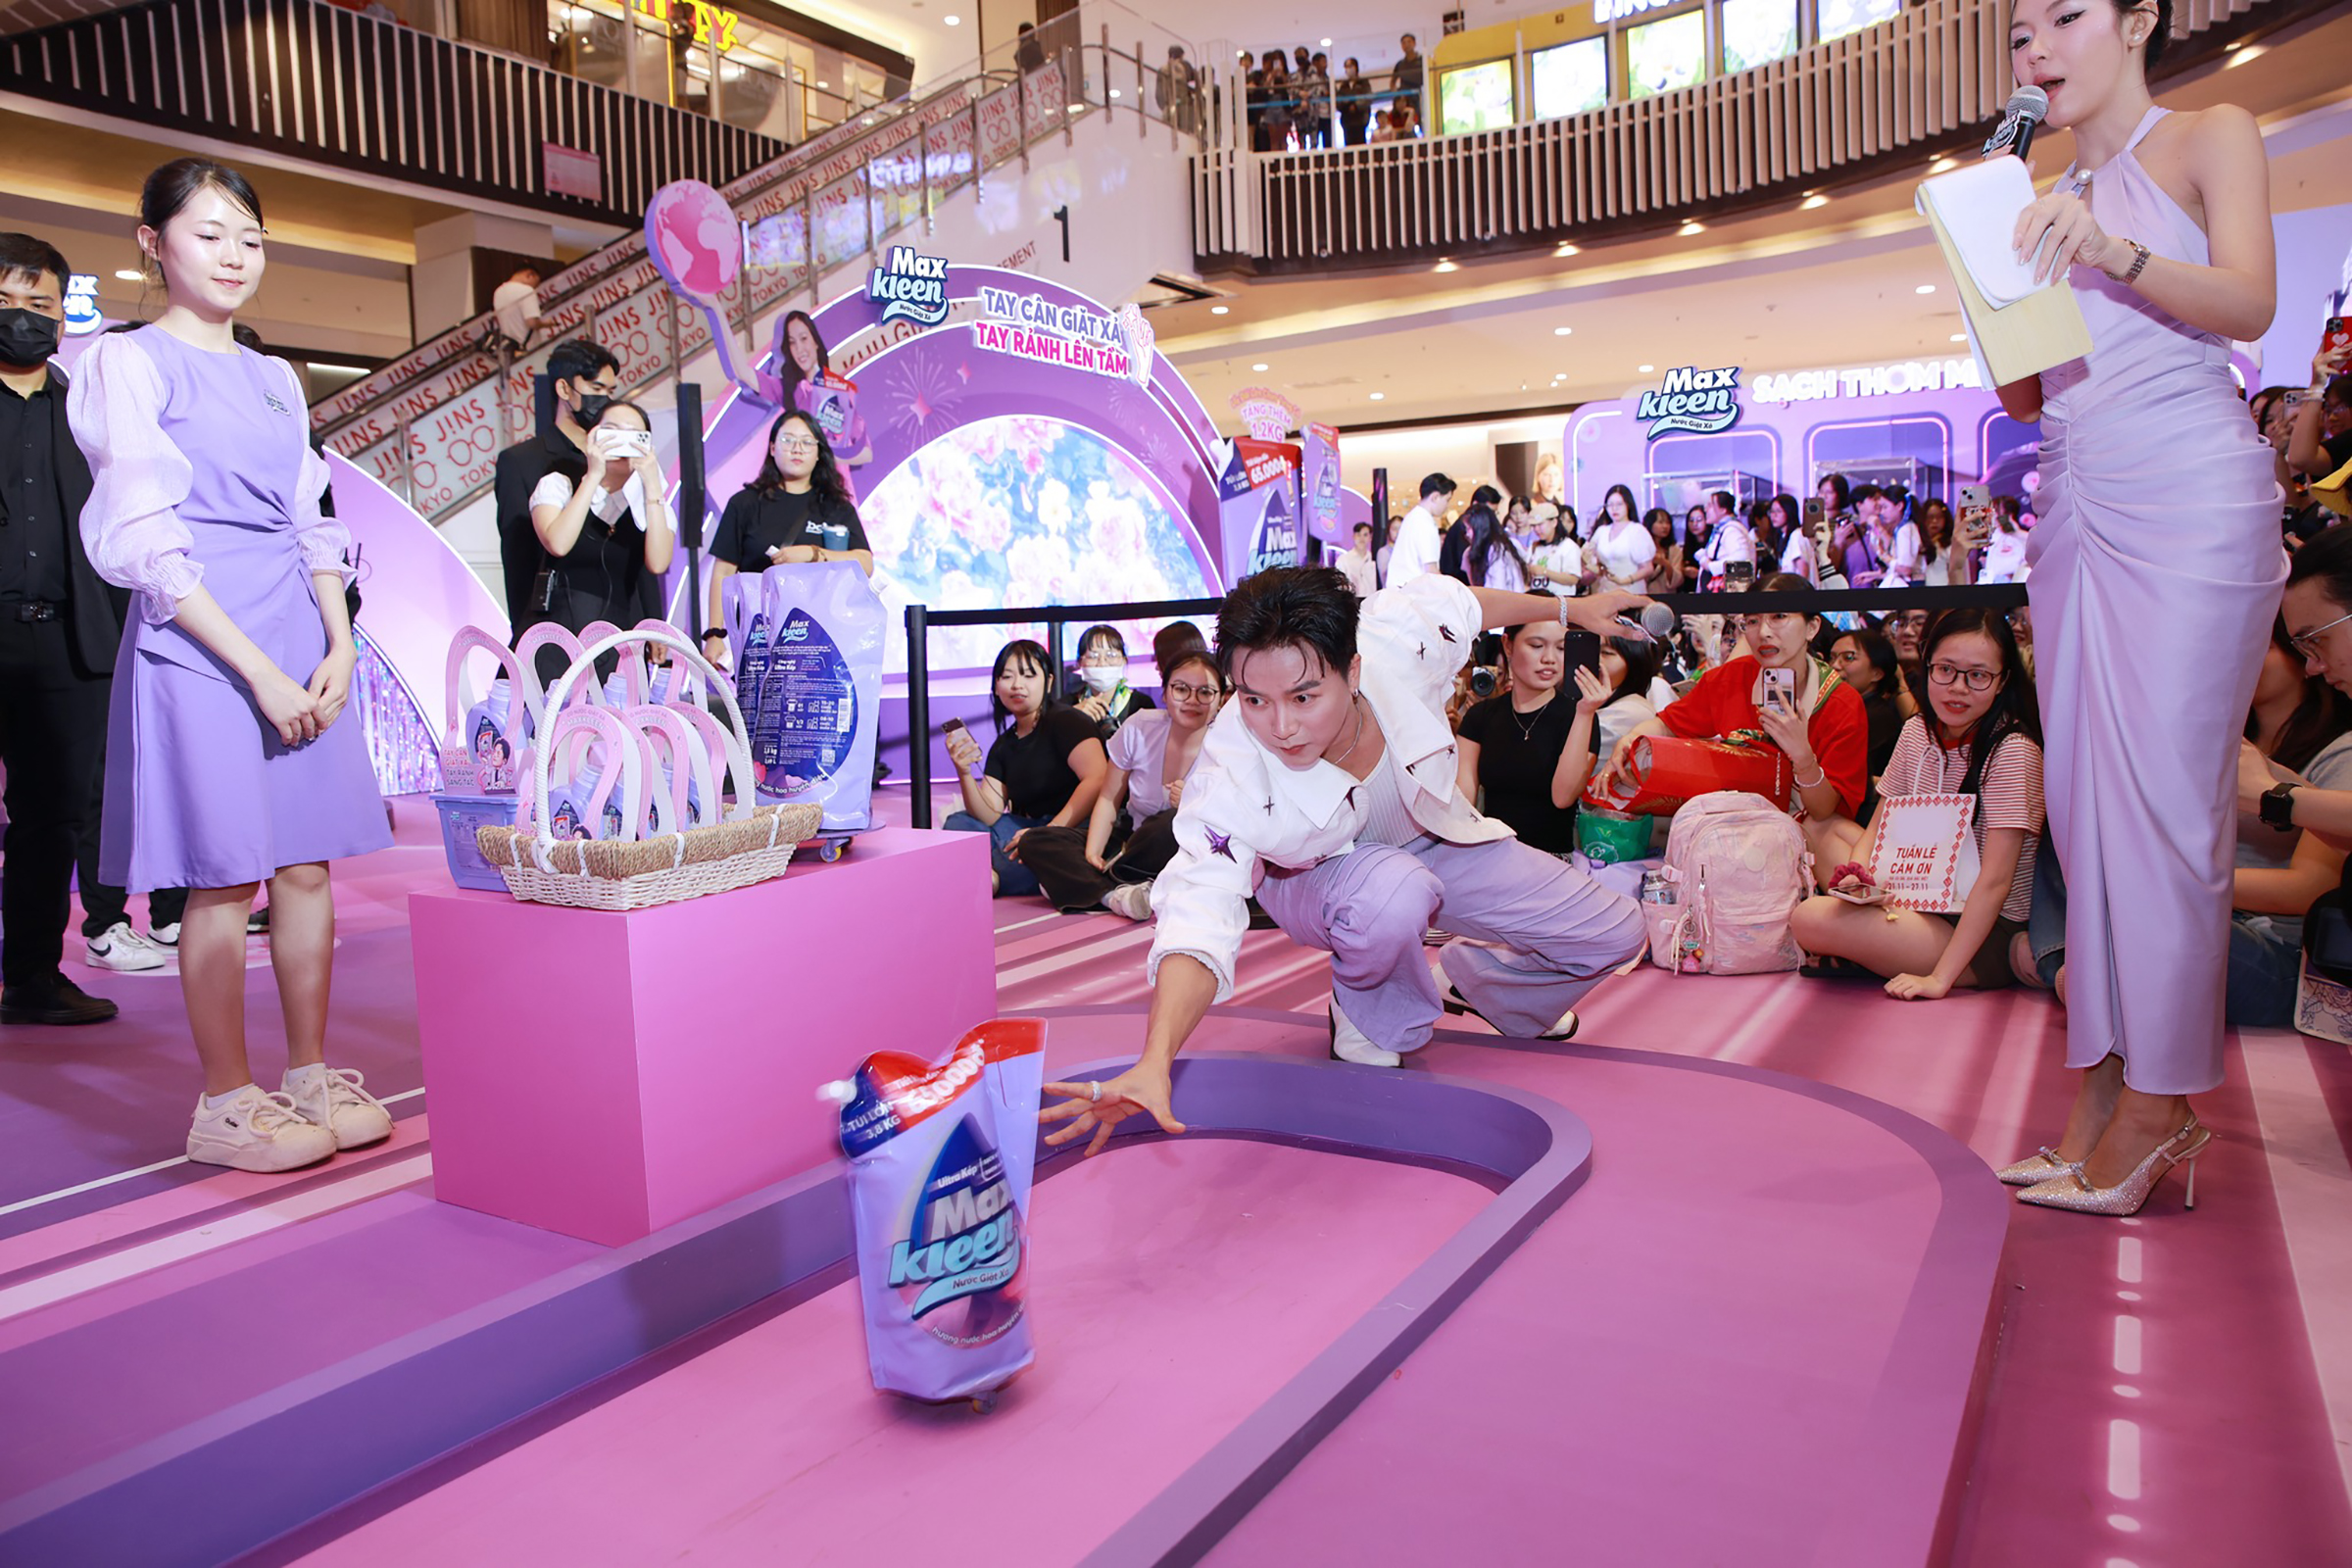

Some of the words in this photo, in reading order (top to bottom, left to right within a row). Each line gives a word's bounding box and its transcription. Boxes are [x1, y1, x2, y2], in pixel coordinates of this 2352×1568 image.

[891, 245, 948, 279] Max
[984, 288, 1017, 317] TAY
[1021, 297, 1057, 327] CÂN
[1061, 307, 1097, 342] GIẶT
[1100, 317, 1121, 343] XẢ
[976, 321, 1009, 350] TAY
[1013, 327, 1060, 362] RẢNH
[1064, 339, 1094, 368] LÊN
[618, 355, 662, 387] TOKYO
[1664, 367, 1740, 394] Max
[1751, 370, 1838, 409] SẠCH
[1840, 360, 1942, 399] THƠM
[790, 619, 809, 628] Max
[884, 1113, 902, 1131] KG
[953, 1276, 978, 1290] Nước
